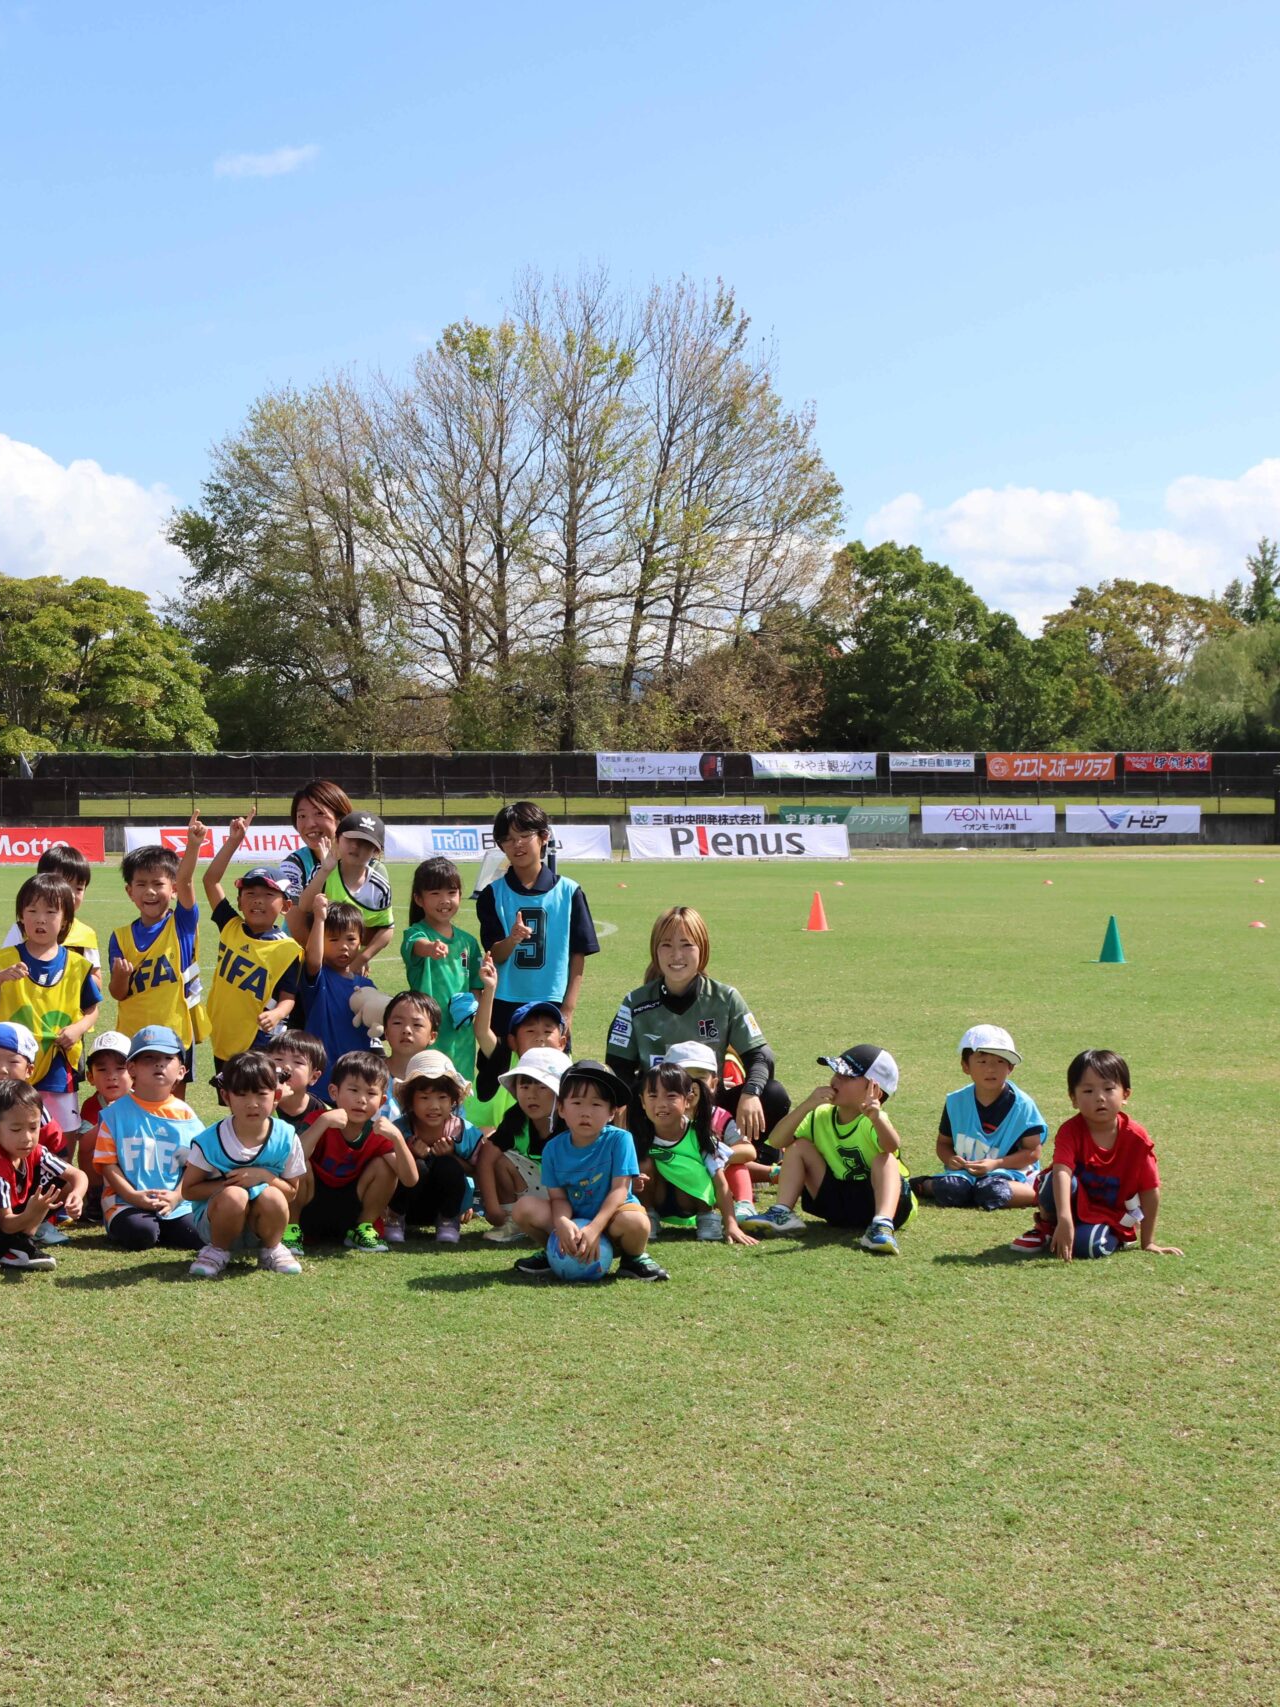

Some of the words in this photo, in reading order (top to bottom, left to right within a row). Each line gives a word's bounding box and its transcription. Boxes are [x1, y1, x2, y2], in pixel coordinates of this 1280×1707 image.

[652, 813, 762, 825] 三重中央開発株式会社
[990, 807, 1032, 821] MALL
[1127, 814, 1168, 829] トピア
[670, 826, 806, 856] Plenus
[217, 943, 269, 1001] IFA
